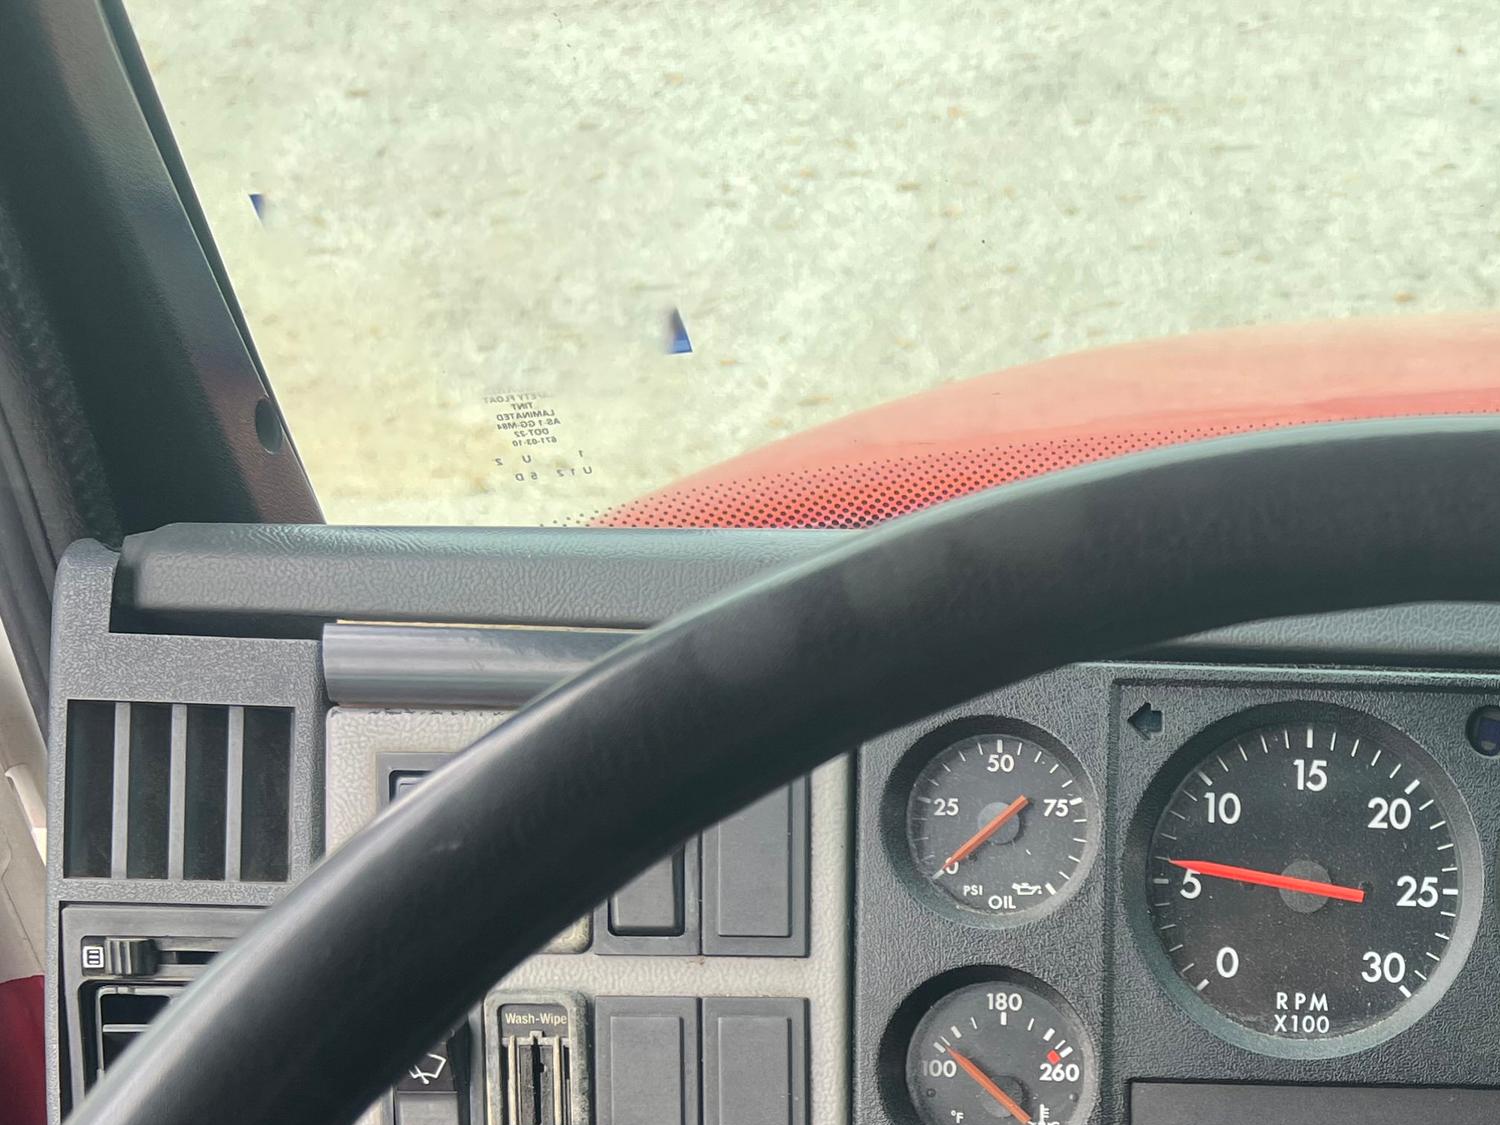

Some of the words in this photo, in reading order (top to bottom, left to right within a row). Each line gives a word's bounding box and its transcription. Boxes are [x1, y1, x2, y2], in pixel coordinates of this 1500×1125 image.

[987, 754, 1014, 773] 50
[1294, 759, 1328, 791] 15
[934, 798, 959, 816] 25
[1043, 799, 1069, 818] 75
[1204, 792, 1242, 825] 10
[1368, 797, 1412, 830] 20
[945, 857, 959, 875] 0
[963, 885, 983, 896] PSI
[1180, 868, 1202, 899] 5
[1396, 876, 1439, 908] 25
[988, 896, 1016, 910] OIL
[1216, 946, 1239, 978] 0
[1362, 951, 1406, 984] 30
[987, 993, 1022, 1011] 180
[1275, 991, 1329, 1012] RPM
[505, 1012, 568, 1026] Wash-Wipe
[1274, 1014, 1330, 1034] X100
[922, 1060, 957, 1078] 100
[1039, 1063, 1079, 1082] 260
